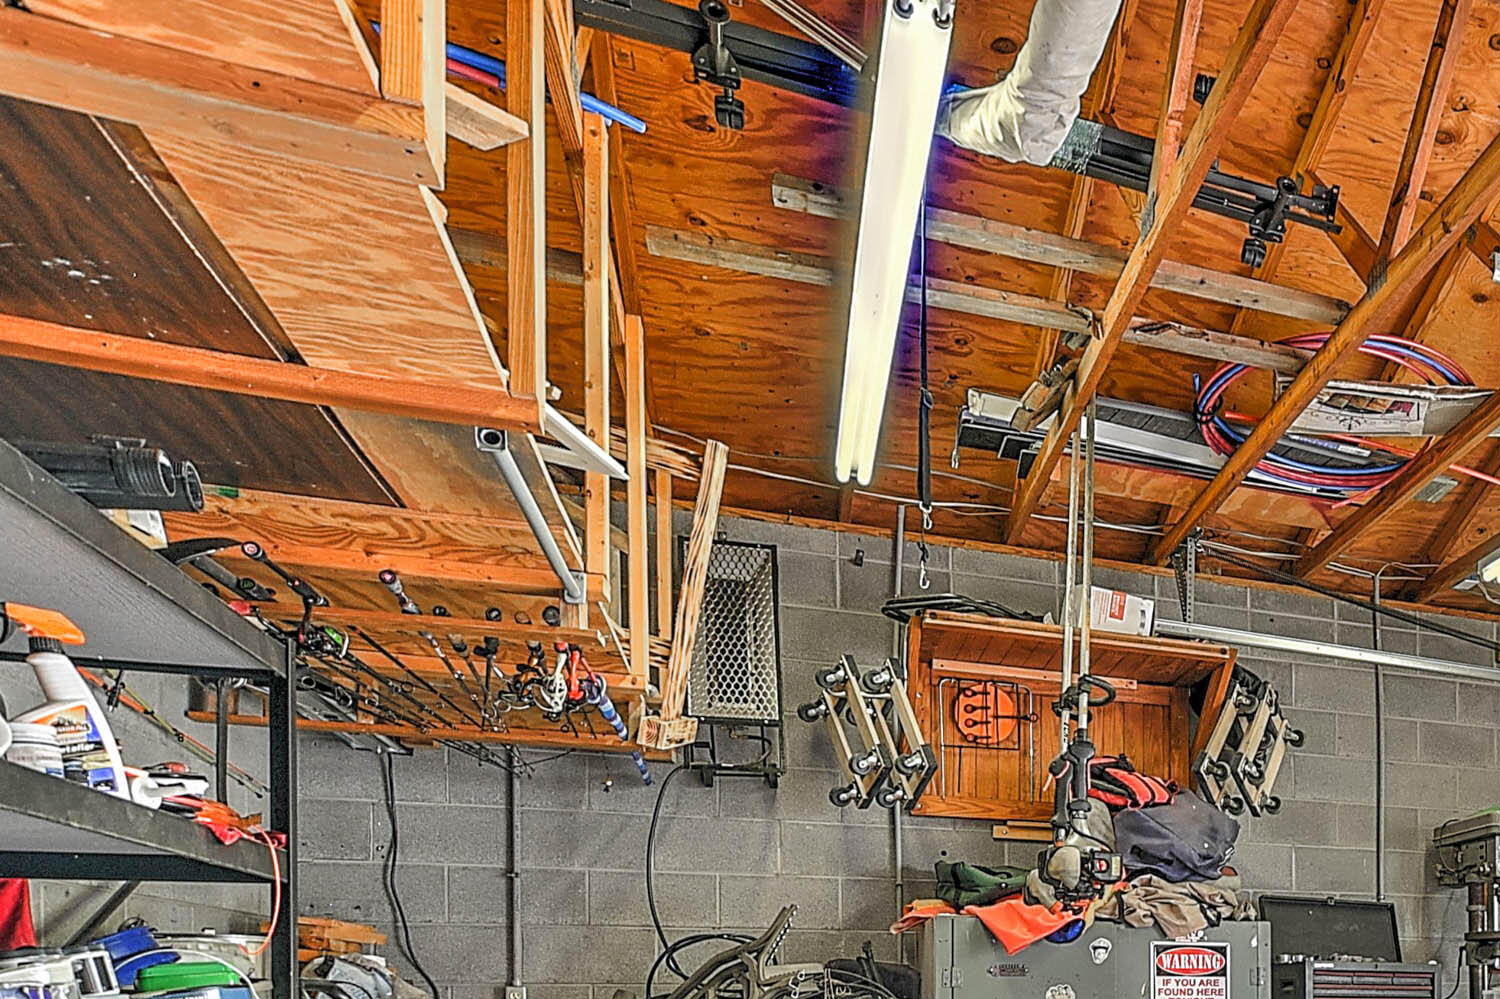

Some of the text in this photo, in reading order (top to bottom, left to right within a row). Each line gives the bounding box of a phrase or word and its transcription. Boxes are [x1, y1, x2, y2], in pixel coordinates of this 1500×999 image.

[1161, 953, 1221, 970] WARNING
[1162, 978, 1220, 987] IF YOU ARE
[1158, 988, 1224, 996] FOUND HERE
